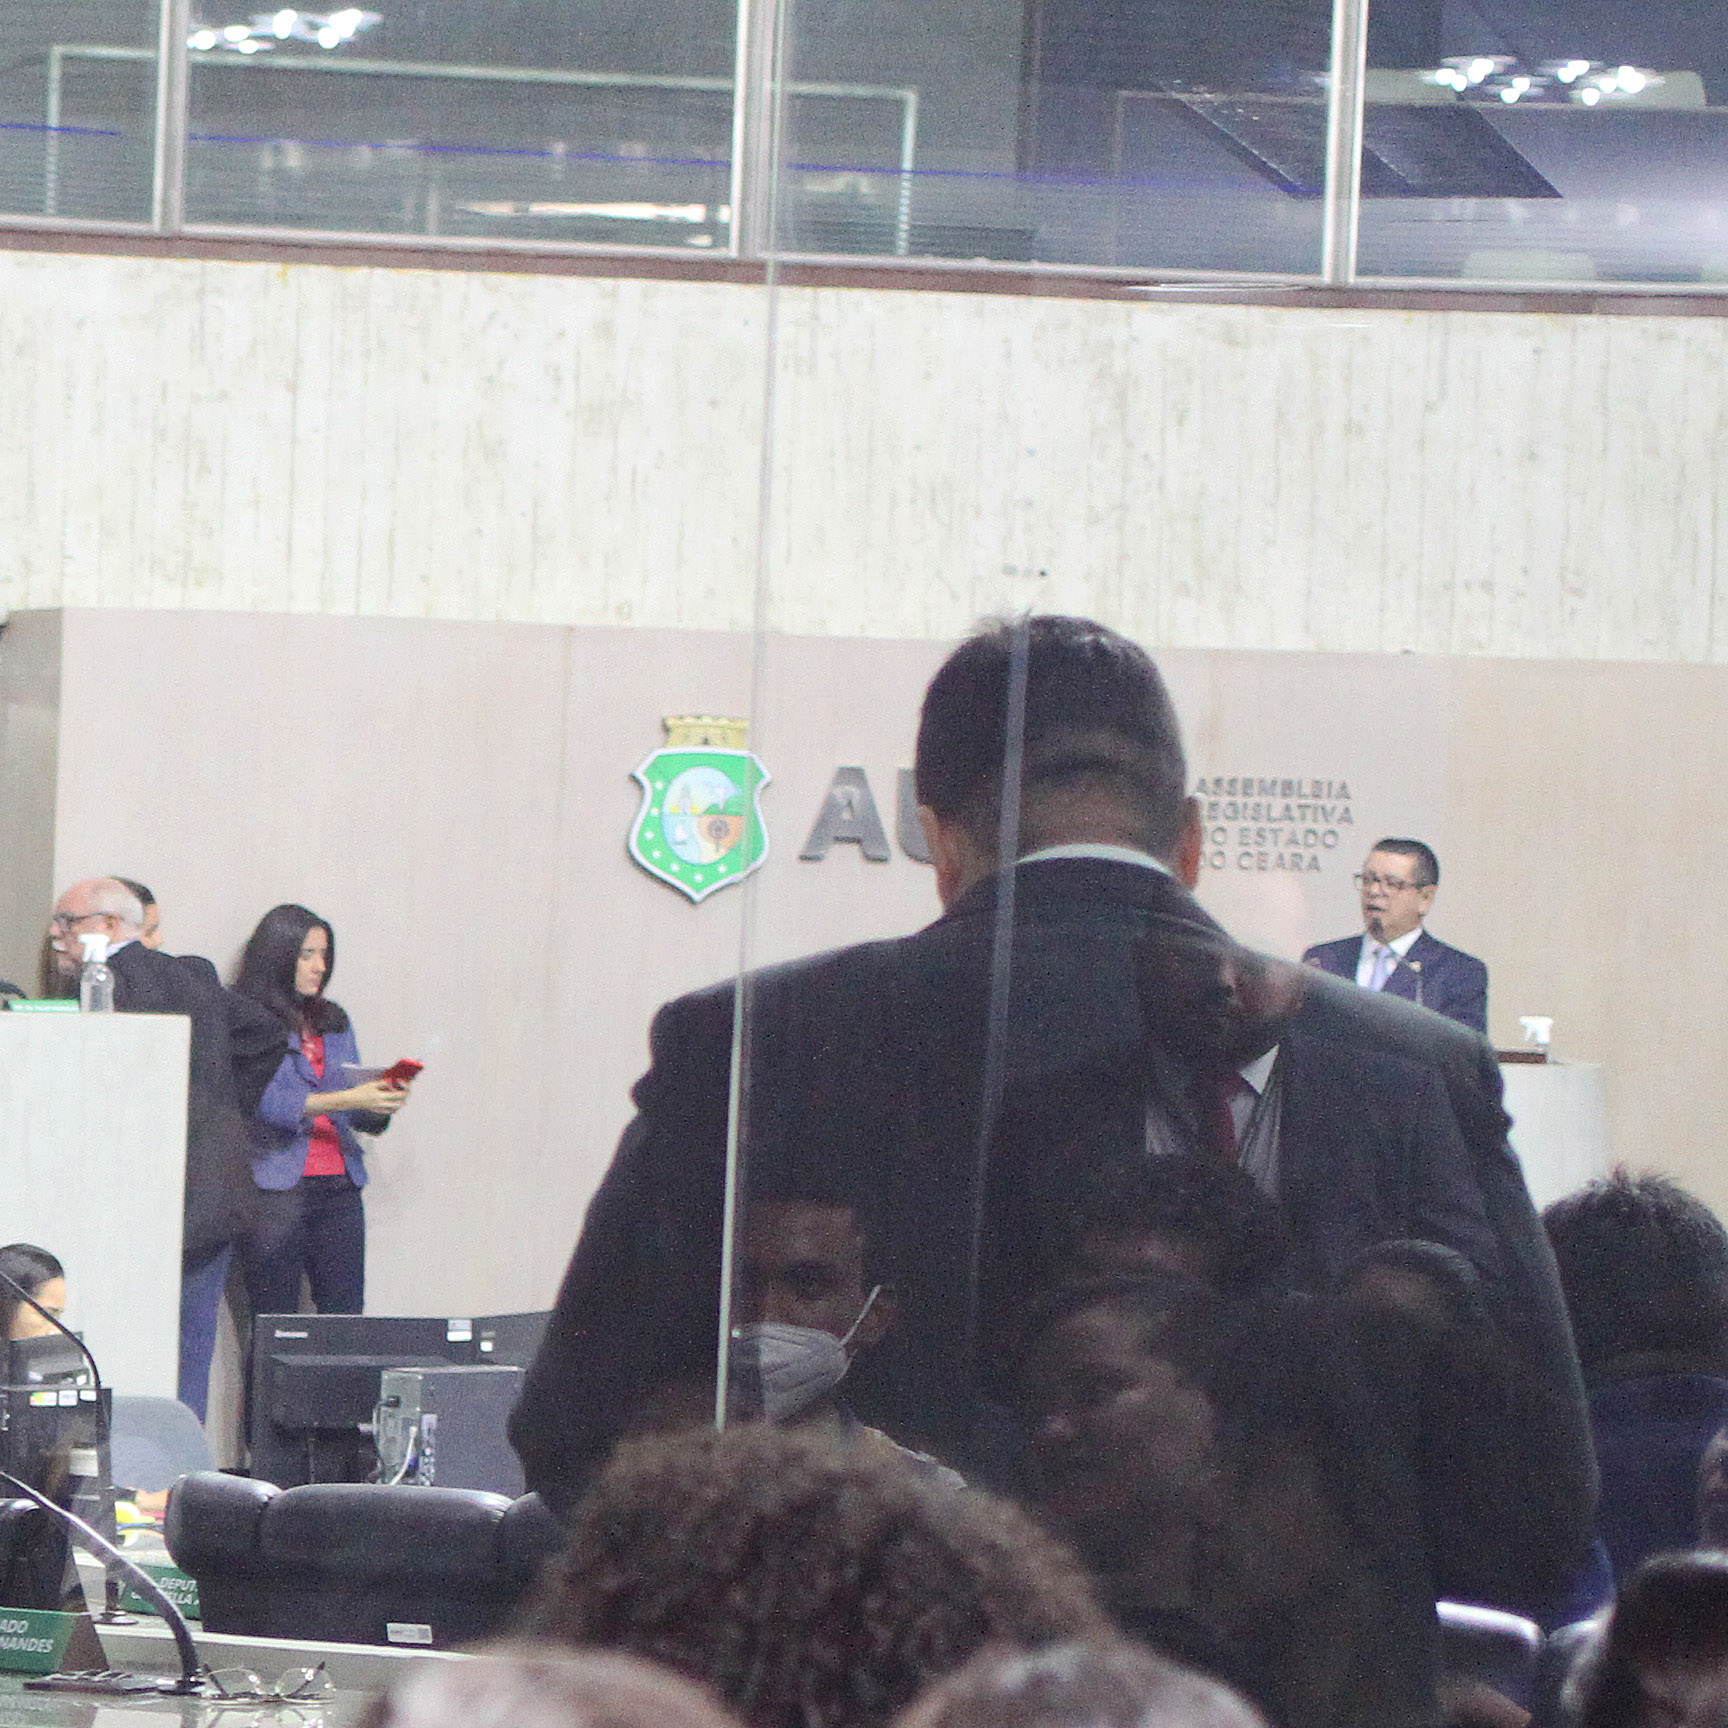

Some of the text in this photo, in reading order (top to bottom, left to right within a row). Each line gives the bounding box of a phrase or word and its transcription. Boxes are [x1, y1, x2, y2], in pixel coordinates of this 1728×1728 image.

[1196, 777, 1351, 799] ASSEMBLEIA
[1202, 801, 1354, 824] EGISLATIVA
[1239, 827, 1339, 848] ESTADO
[158, 1577, 198, 1592] DEPUT
